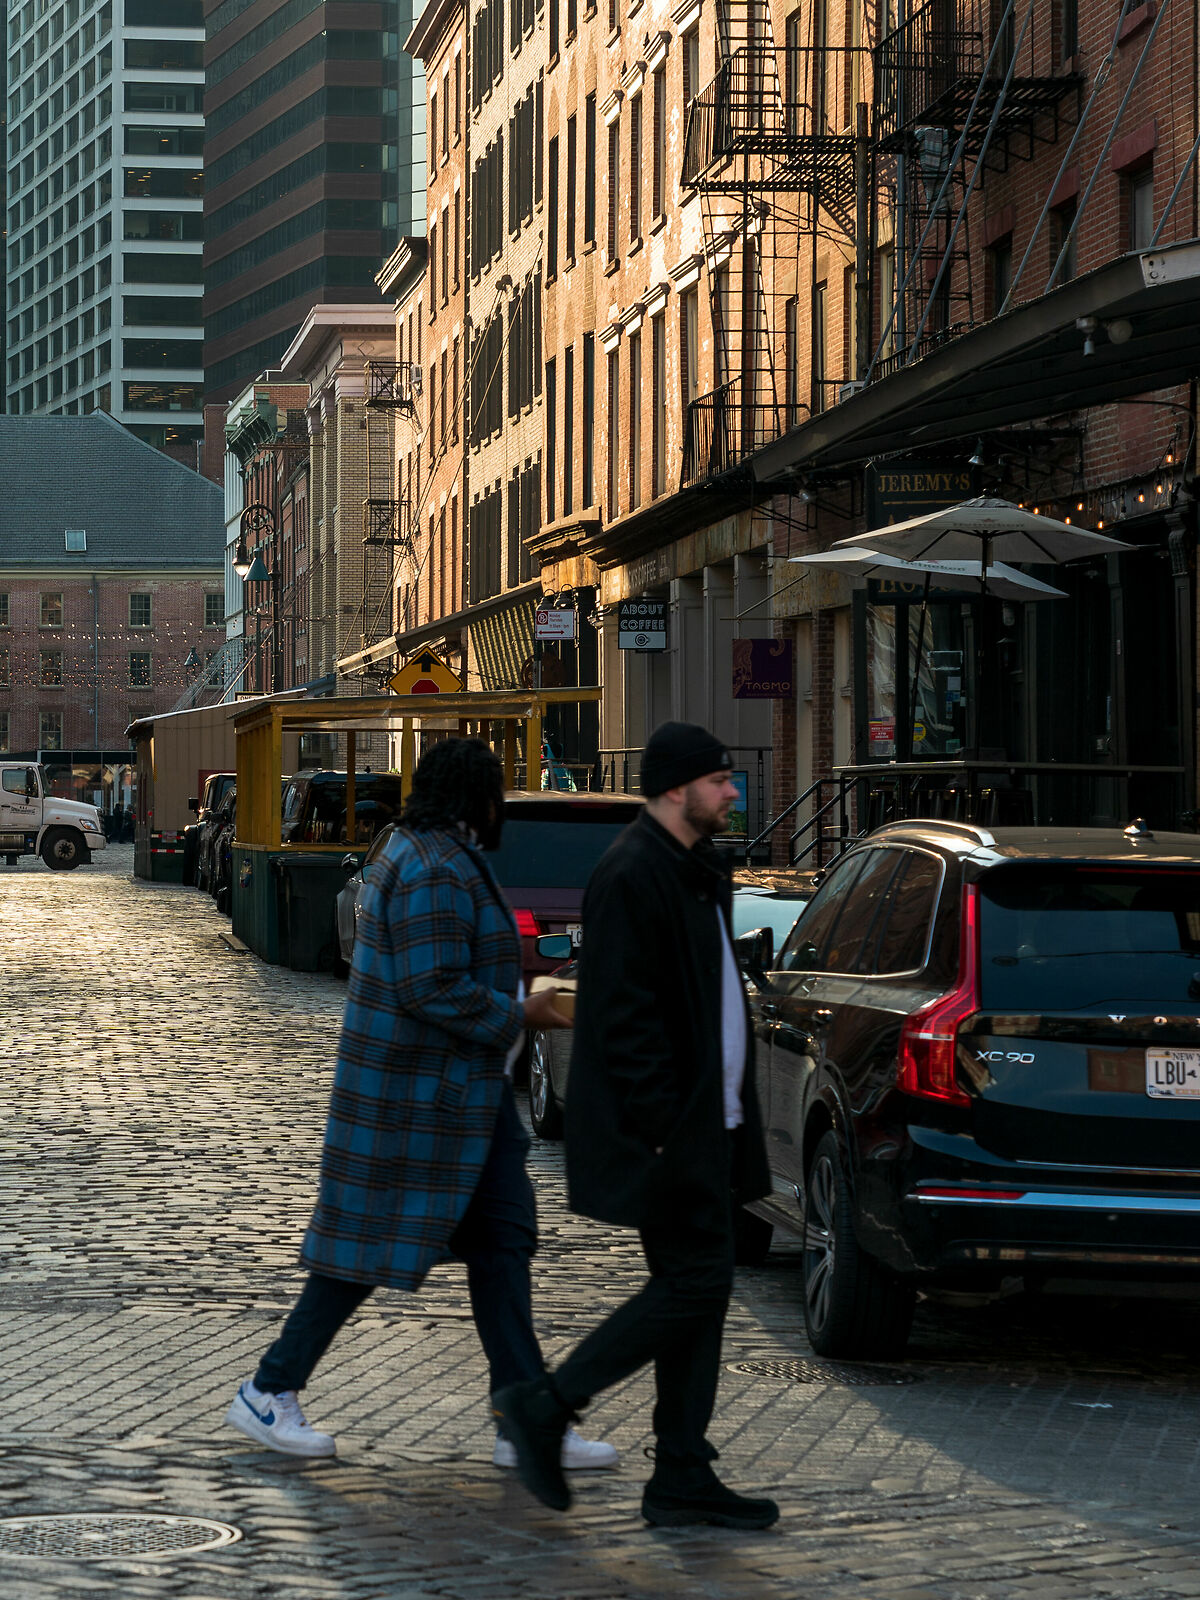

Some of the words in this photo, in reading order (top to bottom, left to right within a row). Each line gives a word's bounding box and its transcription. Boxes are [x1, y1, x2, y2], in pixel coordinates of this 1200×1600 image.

[878, 473, 971, 493] JEREMY'S
[621, 604, 664, 615] ABOUT
[620, 619, 665, 630] COFFEE
[745, 682, 791, 693] TAGMO
[1172, 1052, 1195, 1061] NEW
[1155, 1061, 1186, 1085] LBU
